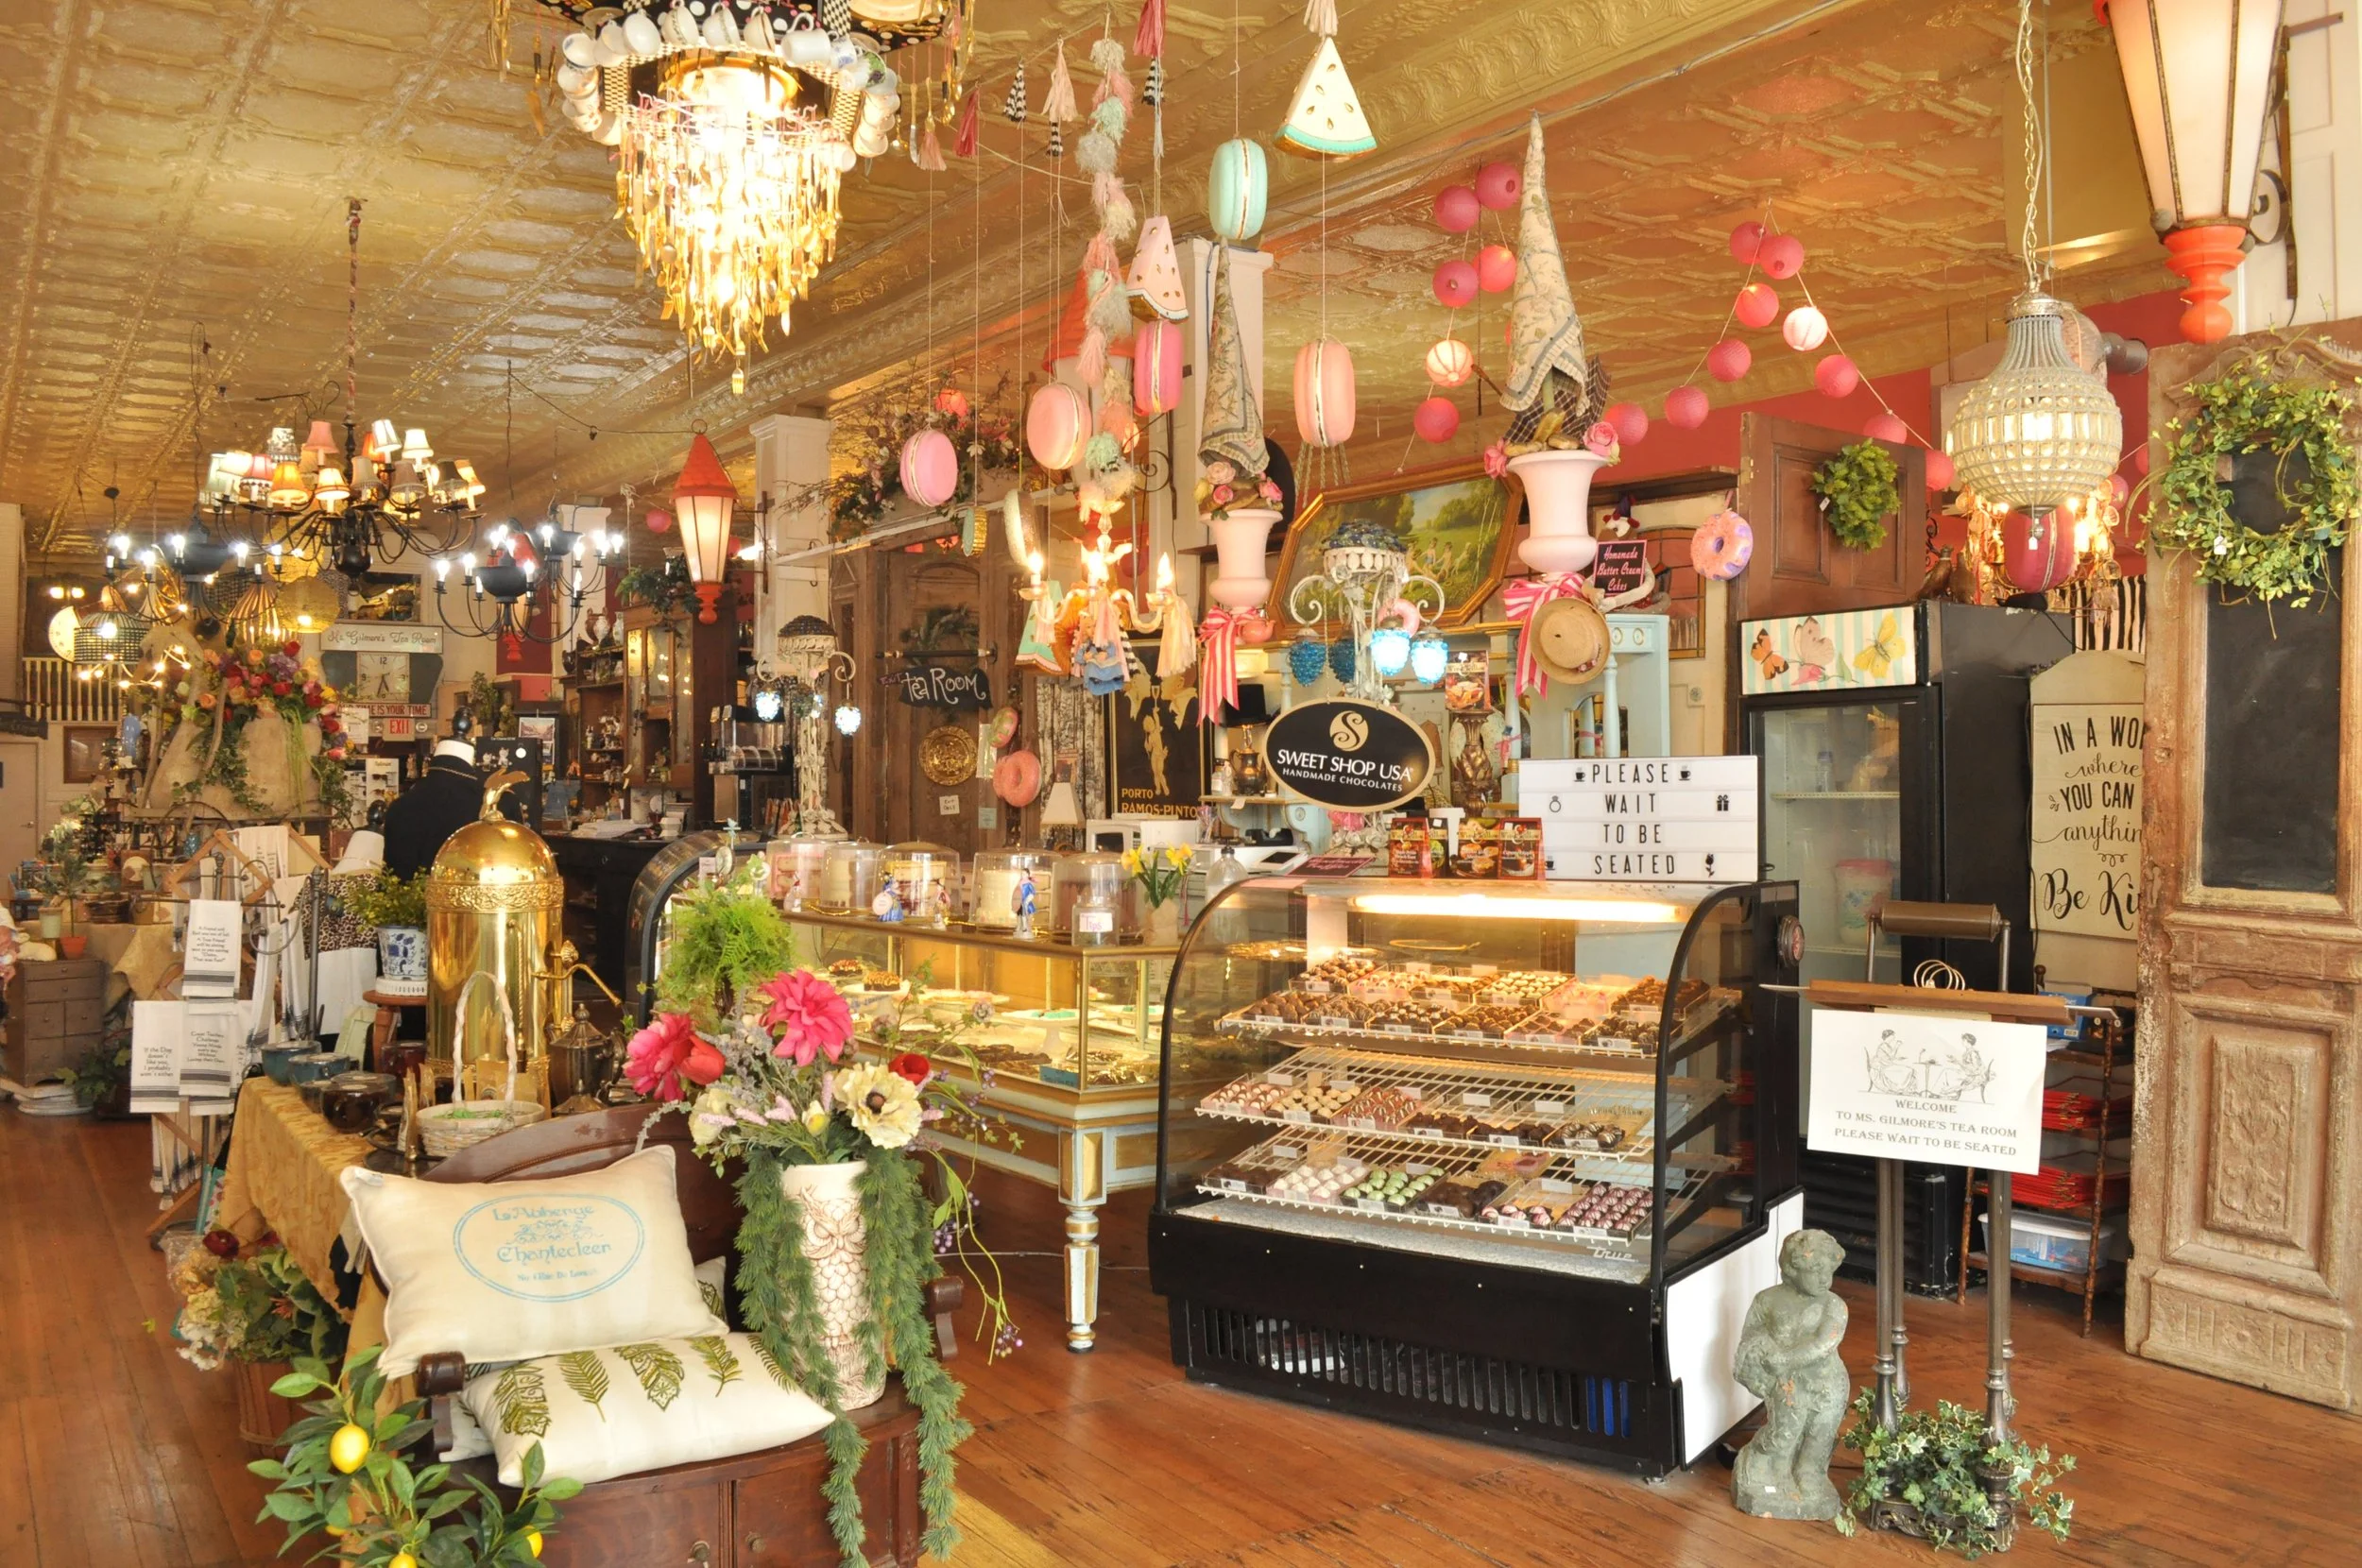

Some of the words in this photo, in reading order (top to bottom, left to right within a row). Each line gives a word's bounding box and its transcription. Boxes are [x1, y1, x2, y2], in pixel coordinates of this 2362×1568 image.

[1603, 545, 1638, 560] Homemade
[1597, 562, 1619, 575] Butter
[1620, 561, 1641, 575] Cream
[1607, 578, 1627, 591] Cakes
[379, 656, 387, 665] 12
[378, 705, 385, 715] IS
[386, 705, 405, 715] YOUR
[408, 705, 427, 715] TIME
[389, 719, 409, 735] EXIT
[2053, 722, 2075, 755] IN
[2086, 717, 2097, 748] A
[1276, 749, 1327, 770] SWEET
[1330, 756, 1376, 776] SHOP
[2064, 752, 2143, 778] where
[1282, 767, 1336, 783] HANDMADE
[1339, 775, 1403, 793] CHOCOLATES
[1592, 763, 1669, 784] PLEASE
[1121, 788, 1154, 799] PORTO
[1605, 793, 1655, 813] WAIT
[2060, 782, 2092, 812] YOU
[2101, 781, 2135, 810] CAN
[1121, 802, 1197, 818] RAMOS-PINTO
[1603, 824, 1624, 844] TO
[1639, 824, 1661, 844] BE
[1594, 854, 1675, 875] SEATED
[2040, 868, 2090, 920] Be
[1895, 1099, 1957, 1114] WELCOME
[1836, 1110, 1852, 1120] TO
[1855, 1113, 1875, 1123] MS.
[1879, 1115, 1947, 1131] GILMORE'S
[1950, 1122, 1977, 1133] TEA
[1981, 1126, 2017, 1137] ROOM
[1835, 1128, 1883, 1142] PLEASE
[1887, 1133, 1920, 1146] WAIT
[1924, 1136, 1941, 1147] TO
[1943, 1139, 1961, 1150] BE
[1964, 1141, 2016, 1156] SEATED
